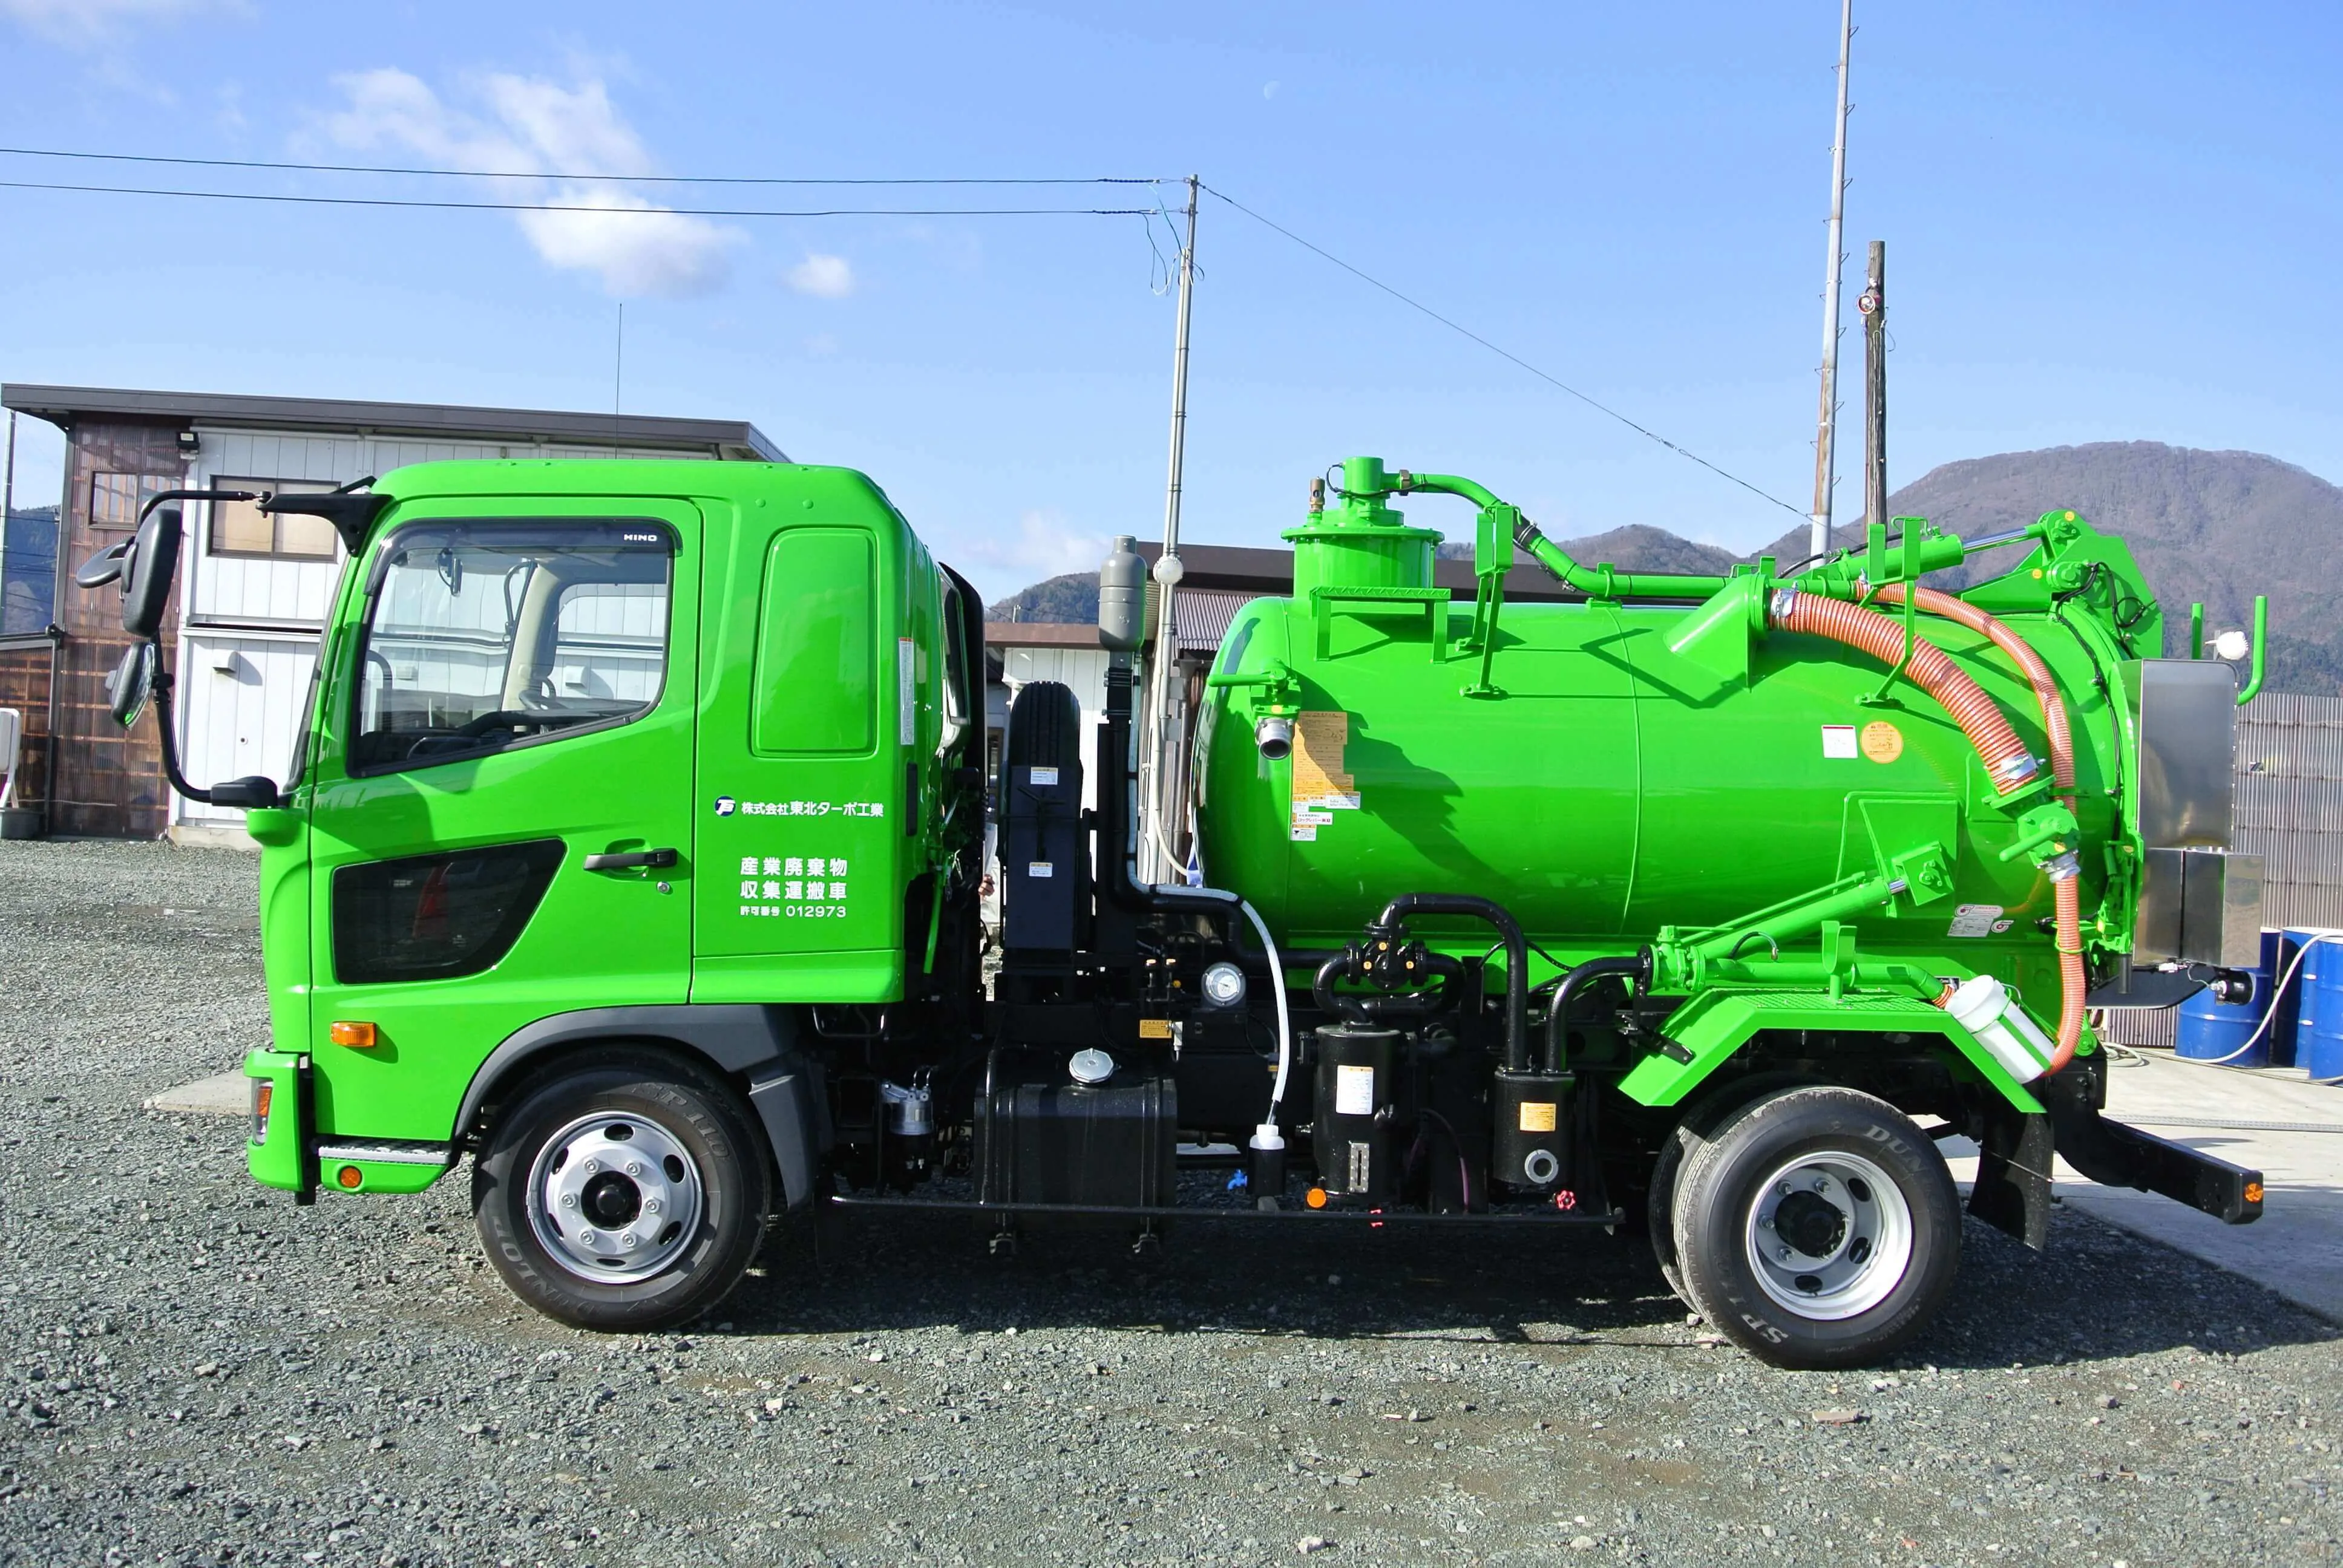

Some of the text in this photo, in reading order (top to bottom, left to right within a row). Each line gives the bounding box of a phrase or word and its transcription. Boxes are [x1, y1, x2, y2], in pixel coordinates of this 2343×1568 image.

[740, 857, 847, 877] 産業廃棄物
[740, 880, 847, 900] 収集運搬車
[785, 906, 847, 917] 012973
[1740, 1312, 1789, 1344] SP
